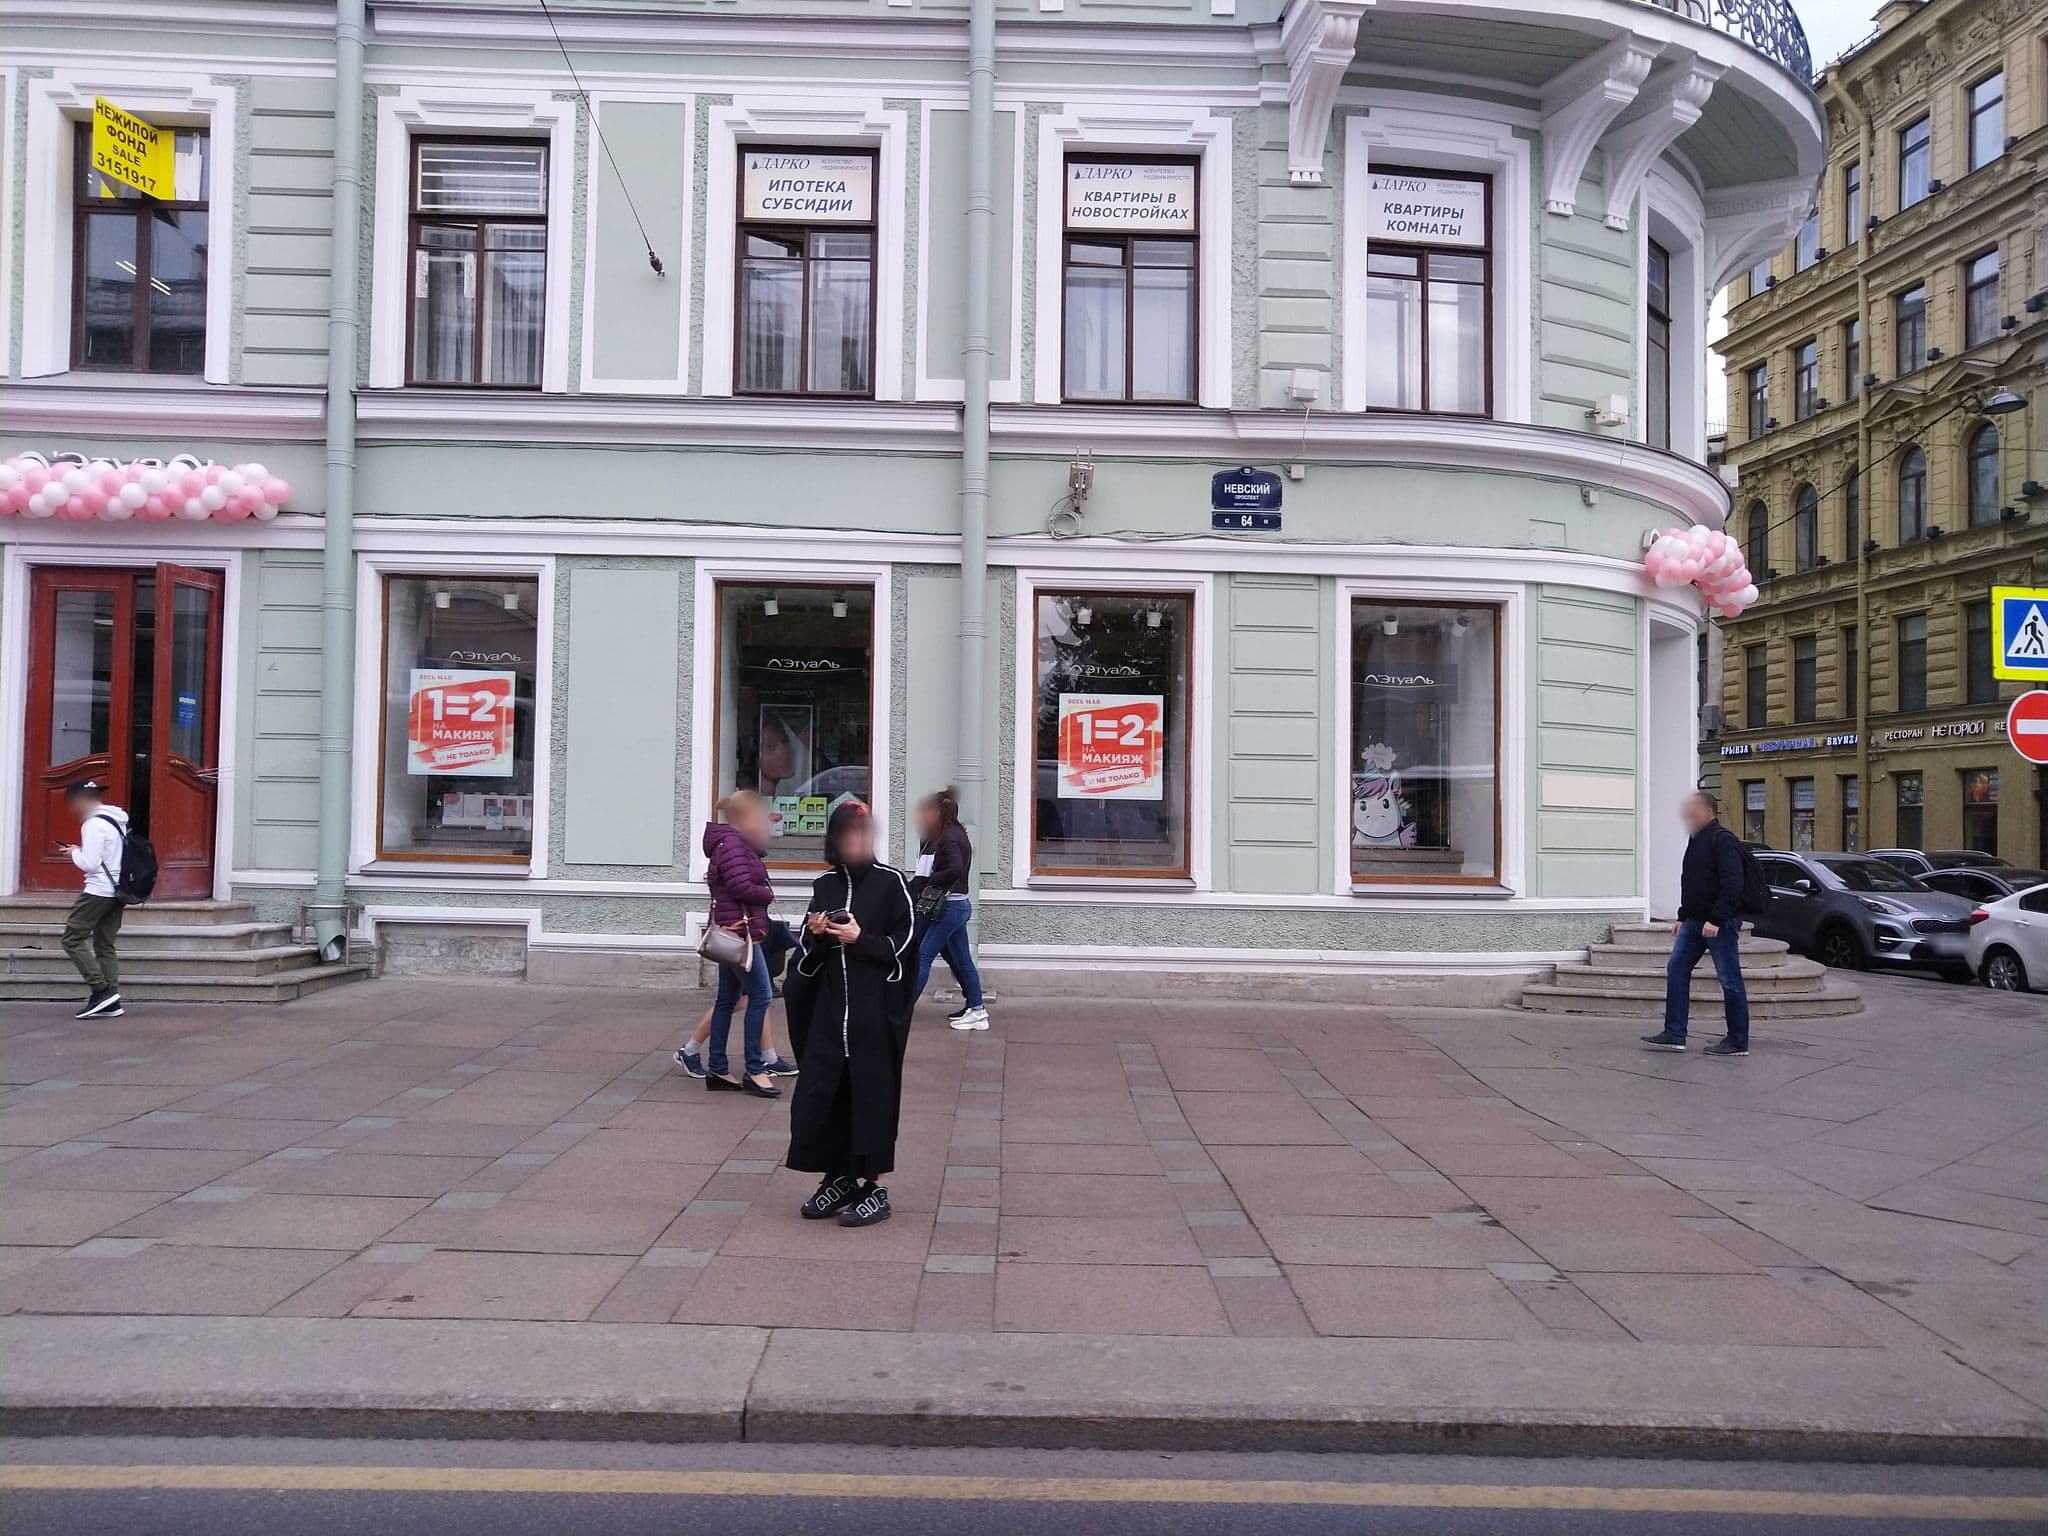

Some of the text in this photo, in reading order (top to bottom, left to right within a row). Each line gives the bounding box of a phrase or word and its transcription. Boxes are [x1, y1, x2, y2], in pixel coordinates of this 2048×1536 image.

[96, 100, 158, 146] НЕЖИЛОЙ
[106, 125, 147, 157] ФОНД
[112, 144, 141, 167] SALE
[758, 157, 810, 170] ДАРКО
[97, 152, 156, 192] 3151917
[1081, 167, 1132, 180] ДАРКО
[768, 180, 846, 193] ИПОТЕКА
[1378, 179, 1427, 193] ДАРКО
[1083, 191, 1177, 203] КВАРТИРЫ В
[762, 197, 853, 213] СУБСИДИИ
[1383, 202, 1464, 219] КВАРТИРЫ
[1071, 205, 1189, 219] НОВОСТРОЙКАХ
[1386, 220, 1462, 236] КОМНАТЫ
[1224, 482, 1270, 494] НЕВСКИЙ
[1241, 515, 1253, 527] 64
[427, 689, 496, 722] 1=2
[432, 729, 495, 741] МАКИЯЖ
[1076, 713, 1145, 746] 1=2
[1884, 729, 1924, 741] РЕСТОРАН
[446, 752, 458, 761] НЕ
[459, 748, 490, 759] ТОЛЬКО
[1082, 745, 1096, 753] НА
[1720, 744, 1749, 756] БРЫНЗА
[1082, 753, 1144, 764] МАКИЯЖ
[1096, 775, 1107, 784] НЕ
[1108, 771, 1140, 782] ТОЛЬКО
